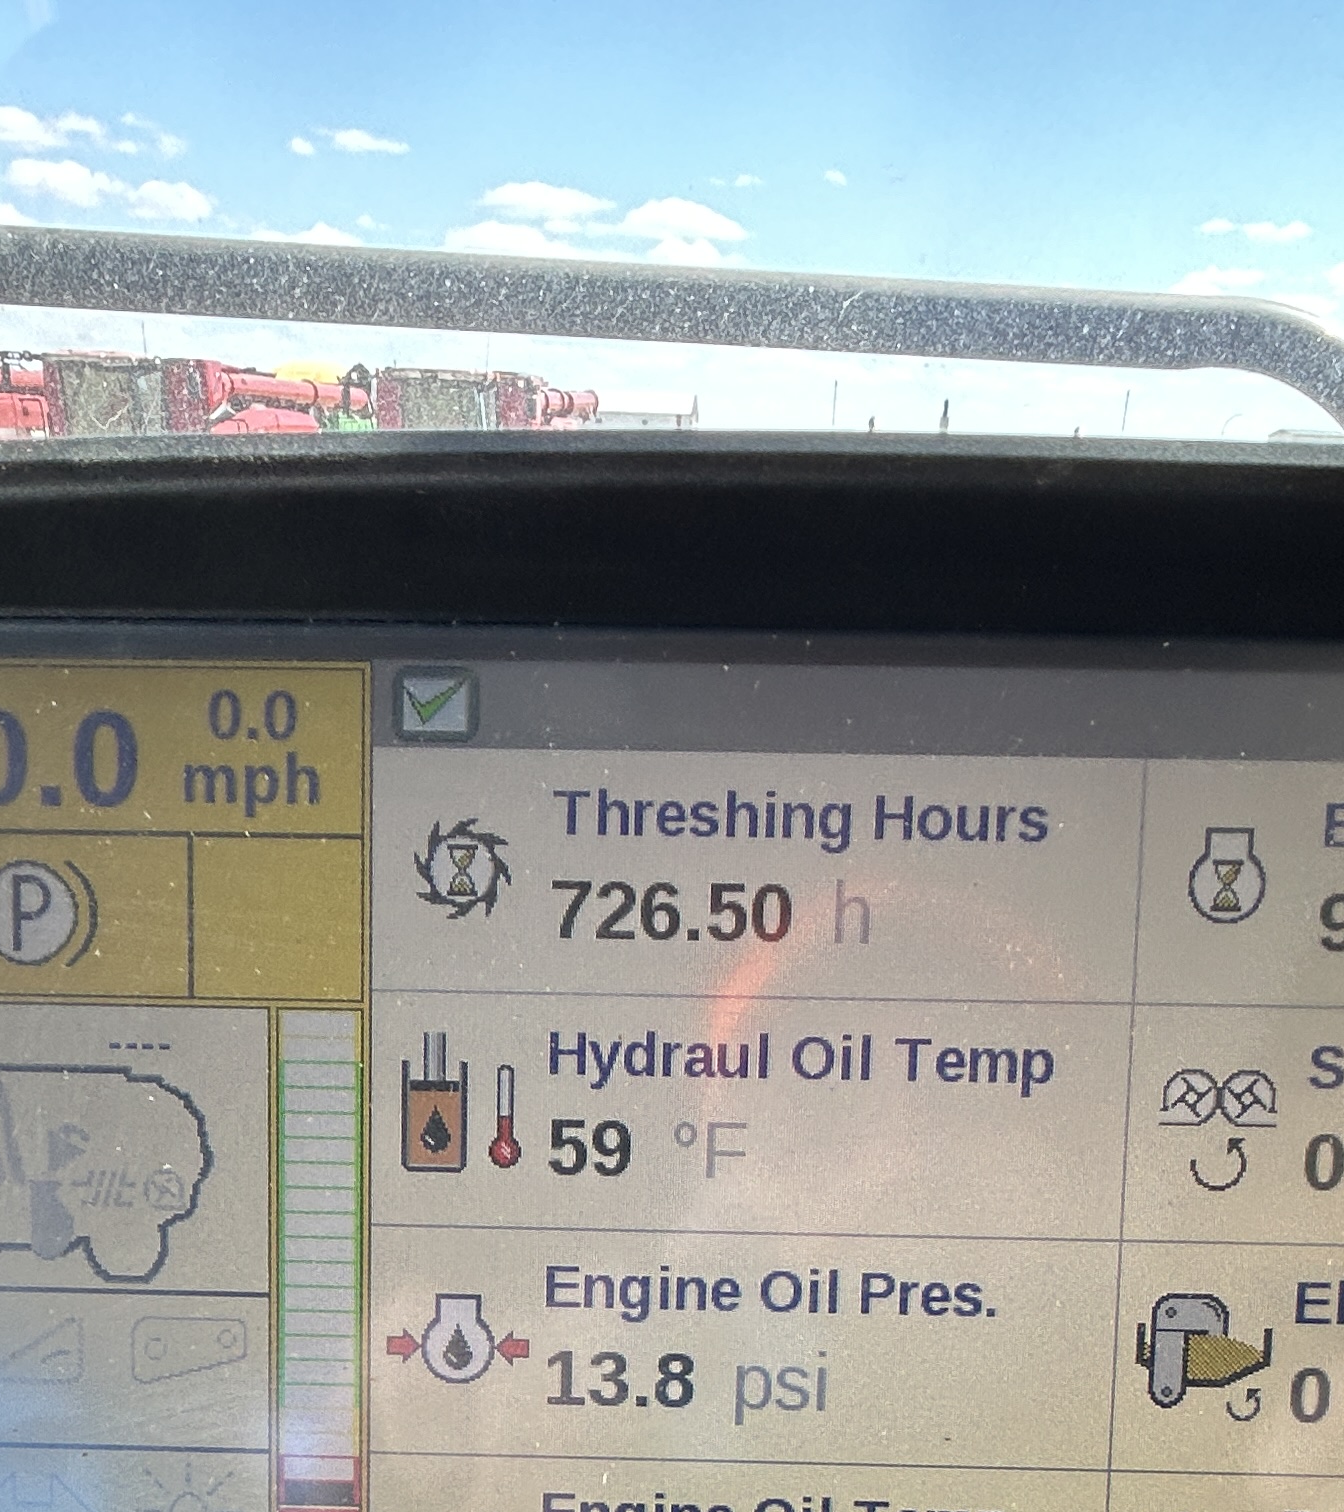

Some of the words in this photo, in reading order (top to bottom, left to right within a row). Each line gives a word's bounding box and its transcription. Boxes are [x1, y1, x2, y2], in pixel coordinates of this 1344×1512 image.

[208, 688, 298, 741] 0.0
[184, 753, 321, 818] mph
[553, 789, 853, 852] Threshing
[873, 795, 1050, 843] Hours
[11, 874, 52, 951] P
[551, 880, 792, 943] 726.50
[834, 879, 871, 945] h
[548, 1029, 770, 1089] Hydraul
[791, 1034, 872, 1081] Oil
[895, 1037, 1055, 1098] Temp
[548, 1118, 631, 1177] 59
[673, 1120, 749, 1178] °F
[544, 1265, 741, 1322] Engine
[760, 1268, 838, 1315] Oil
[860, 1272, 998, 1319] Pres.
[546, 1350, 696, 1408] 13.8
[734, 1350, 827, 1425] psi
[1290, 1367, 1330, 1423] 0
